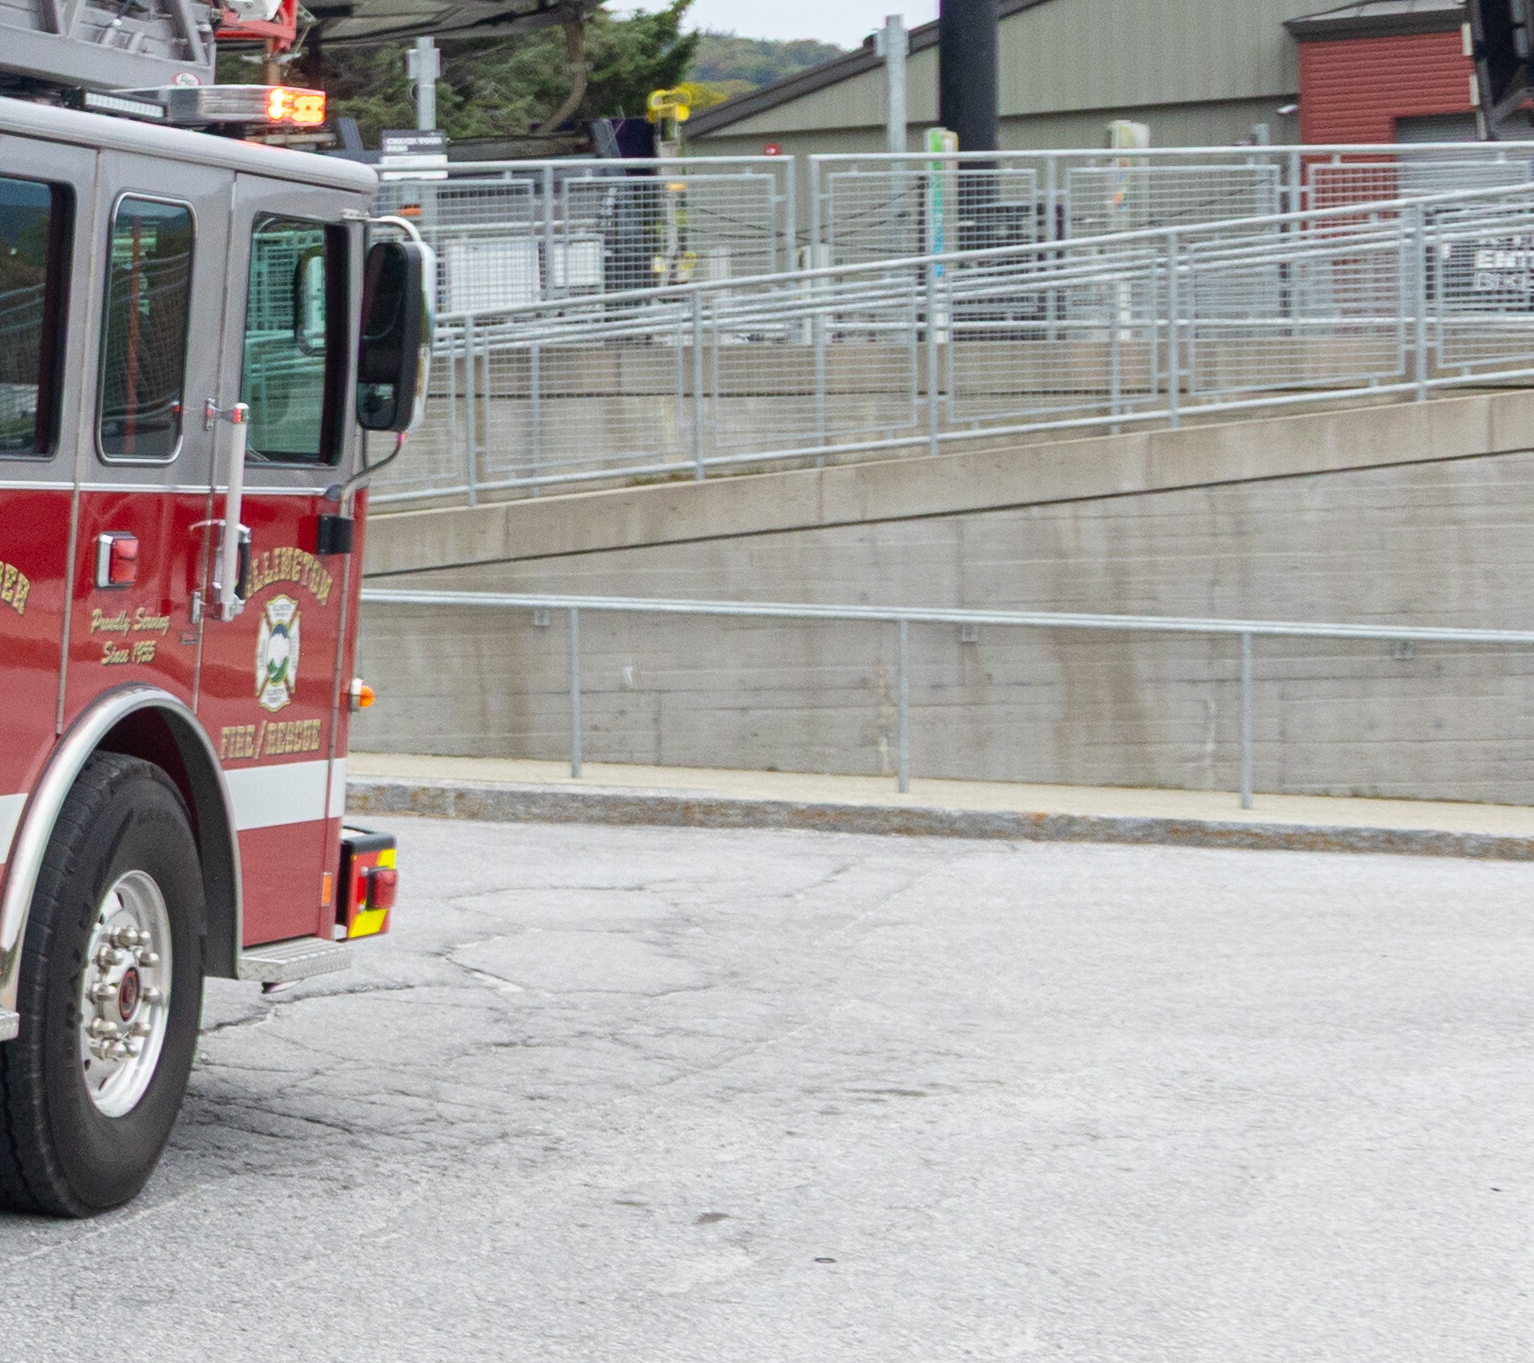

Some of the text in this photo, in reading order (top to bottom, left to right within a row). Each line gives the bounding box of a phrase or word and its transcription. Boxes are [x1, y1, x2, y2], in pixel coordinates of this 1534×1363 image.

[246, 547, 333, 606] ILLINGTON
[91, 607, 170, 635] Proudly Serving
[101, 641, 129, 665] Since
